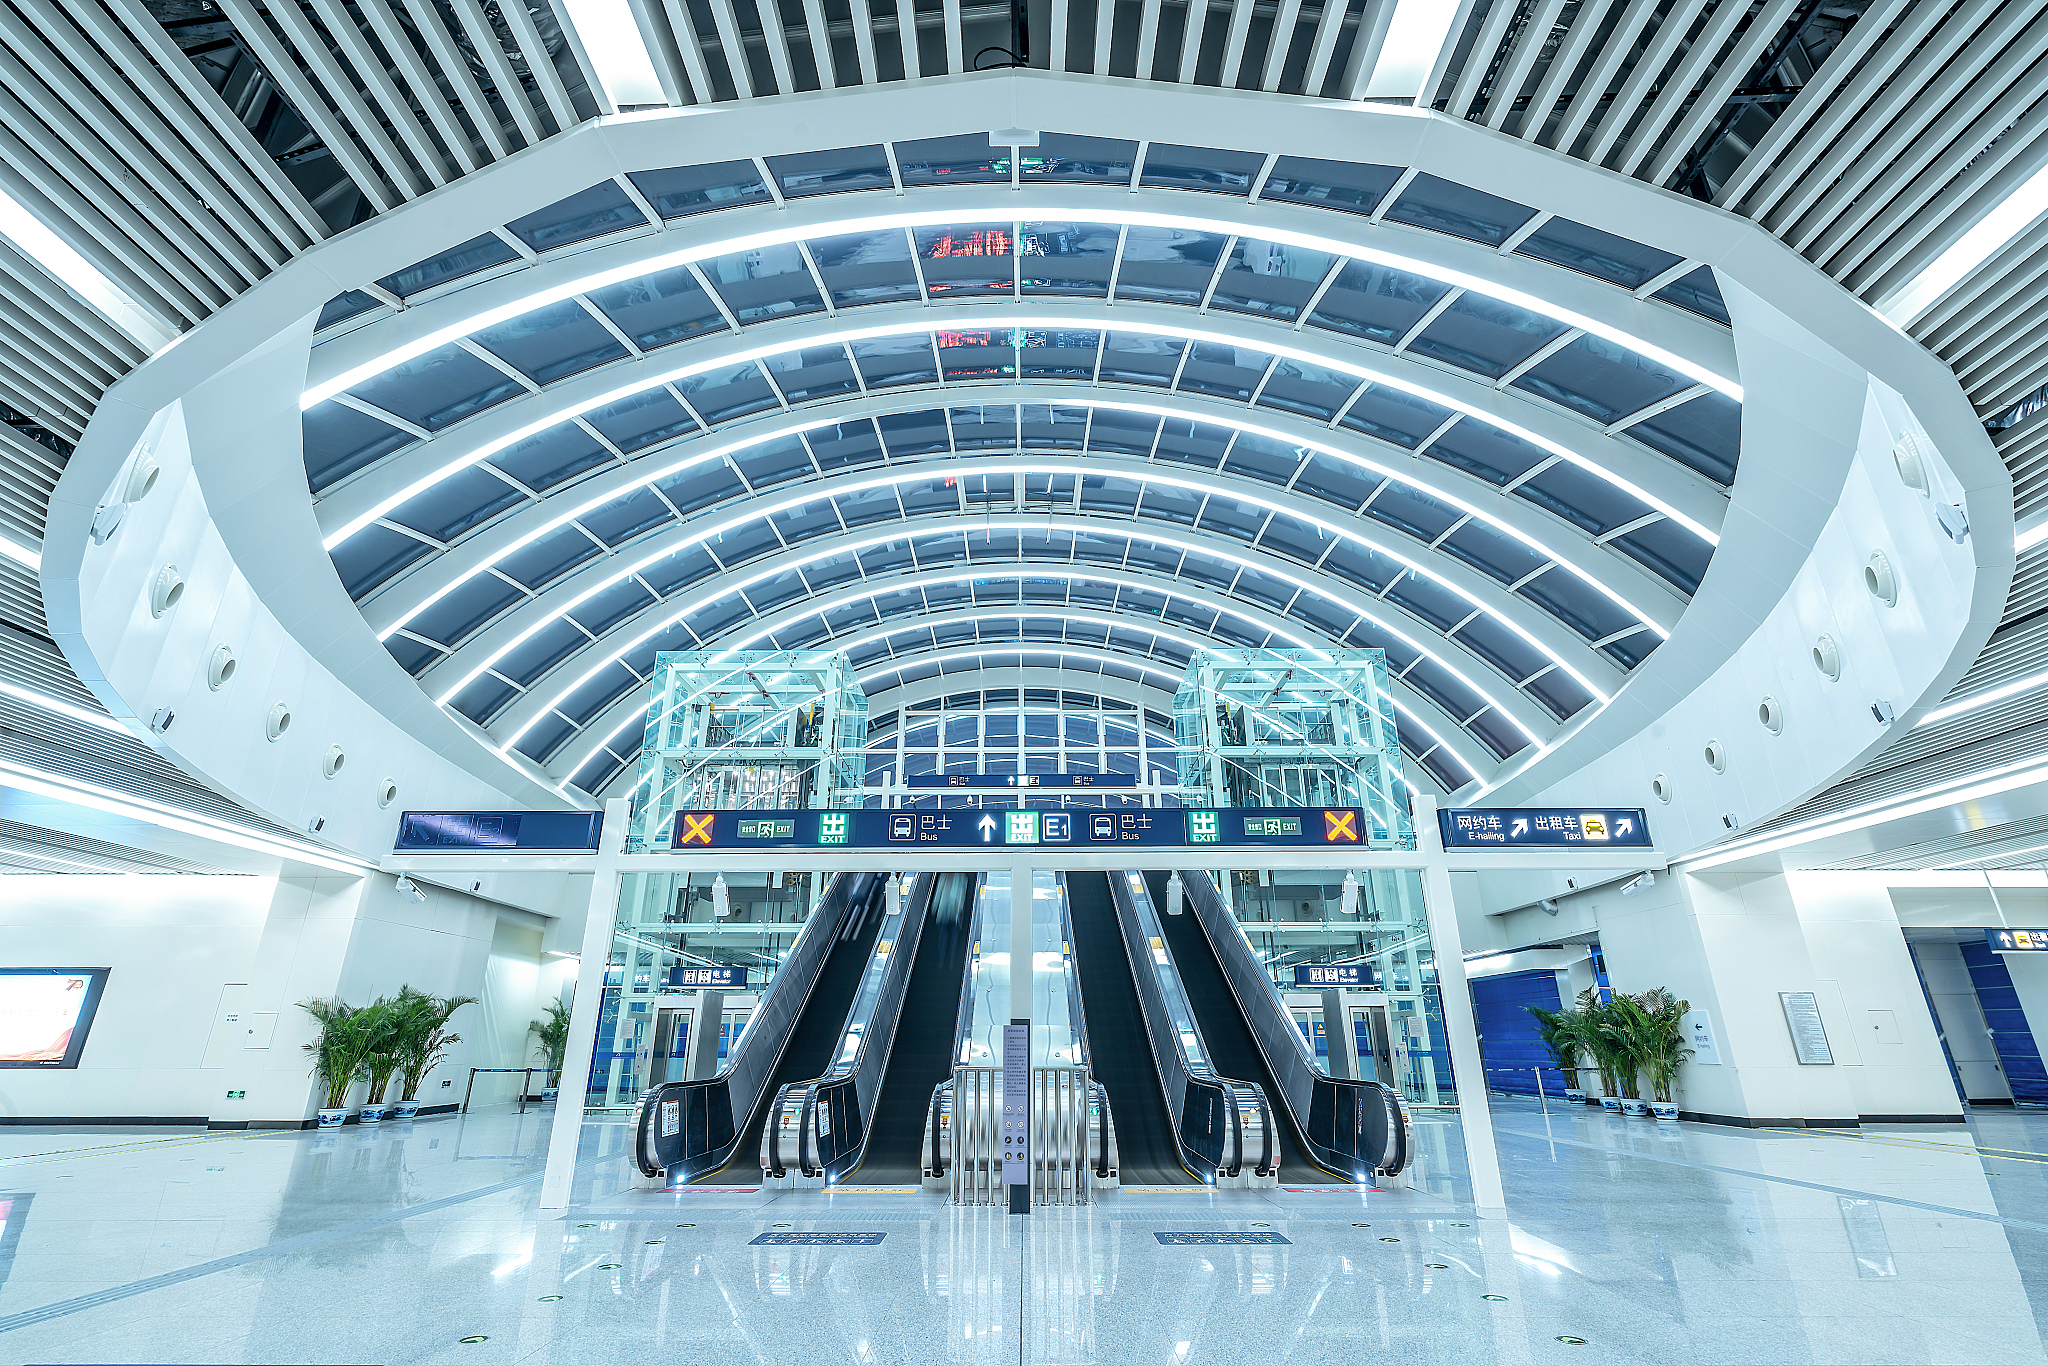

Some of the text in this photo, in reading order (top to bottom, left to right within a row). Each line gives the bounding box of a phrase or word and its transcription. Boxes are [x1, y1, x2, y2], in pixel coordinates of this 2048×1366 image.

[920, 814, 952, 830] 巴士
[1121, 814, 1153, 829] 巴士
[1457, 815, 1503, 830] 网约车
[1535, 815, 1578, 830] 出租车
[478, 822, 500, 838] E2
[776, 825, 791, 833] EXIT
[1045, 818, 1068, 836] E1
[1282, 823, 1297, 831] EXIT
[442, 836, 463, 844] EXIT
[821, 835, 845, 843] EXIT
[920, 832, 938, 841] Bus
[1011, 834, 1033, 842] EXIT
[1121, 832, 1140, 841] Bus
[1193, 834, 1217, 842] EXIT
[1468, 832, 1505, 841] E-hailing
[1563, 831, 1582, 841] Taxi
